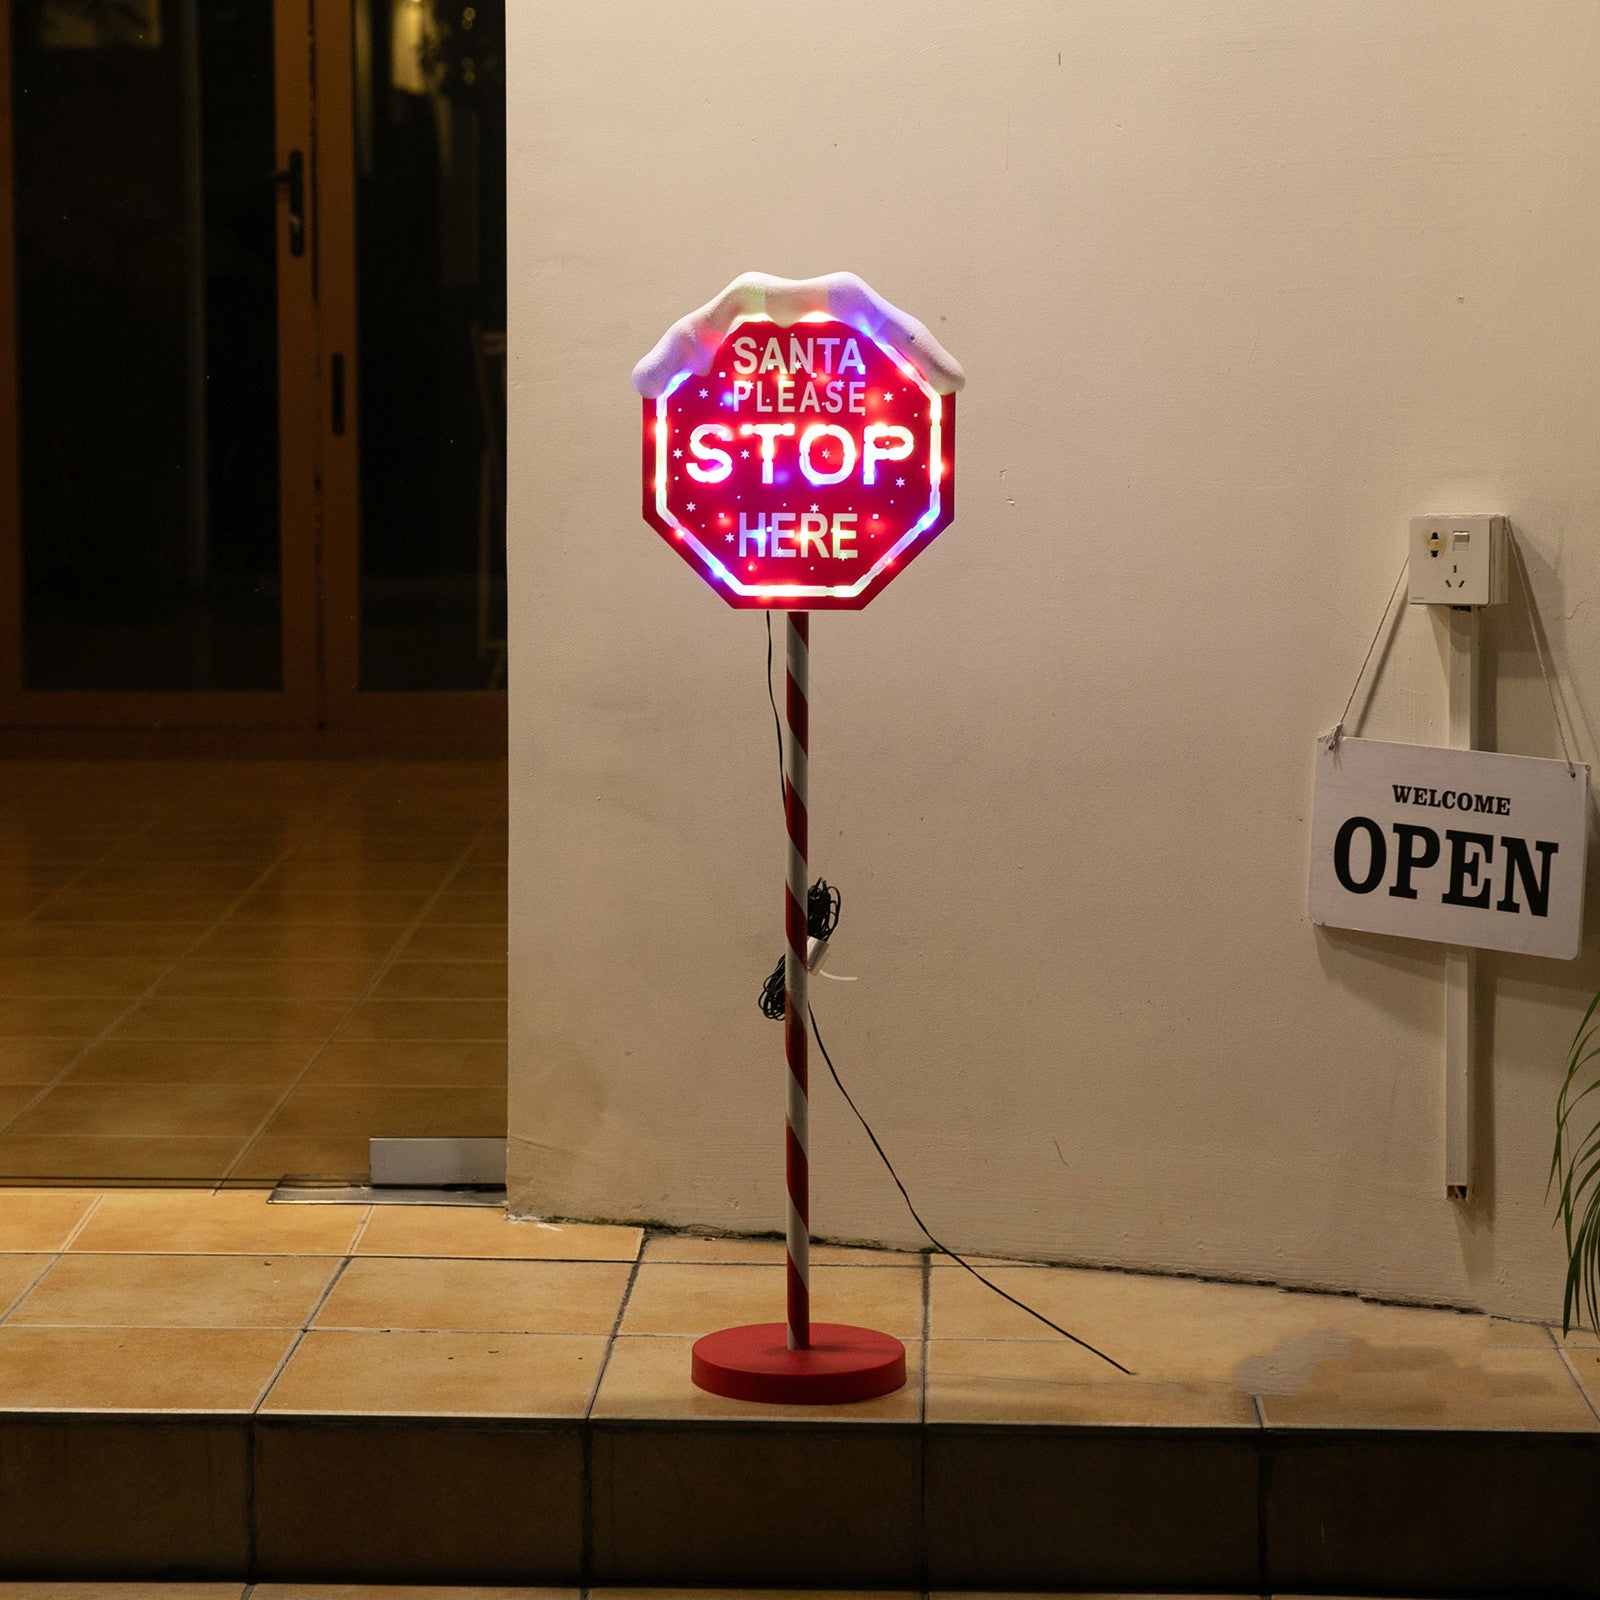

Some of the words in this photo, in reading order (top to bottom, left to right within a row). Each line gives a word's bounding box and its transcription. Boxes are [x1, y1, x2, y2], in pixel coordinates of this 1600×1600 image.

[733, 337, 866, 374] SANTA
[733, 381, 866, 413] PLEASE
[686, 423, 914, 485] STOP
[738, 512, 858, 558] HERE
[1392, 785, 1511, 816] WELCOME
[1334, 816, 1559, 917] OPEN
